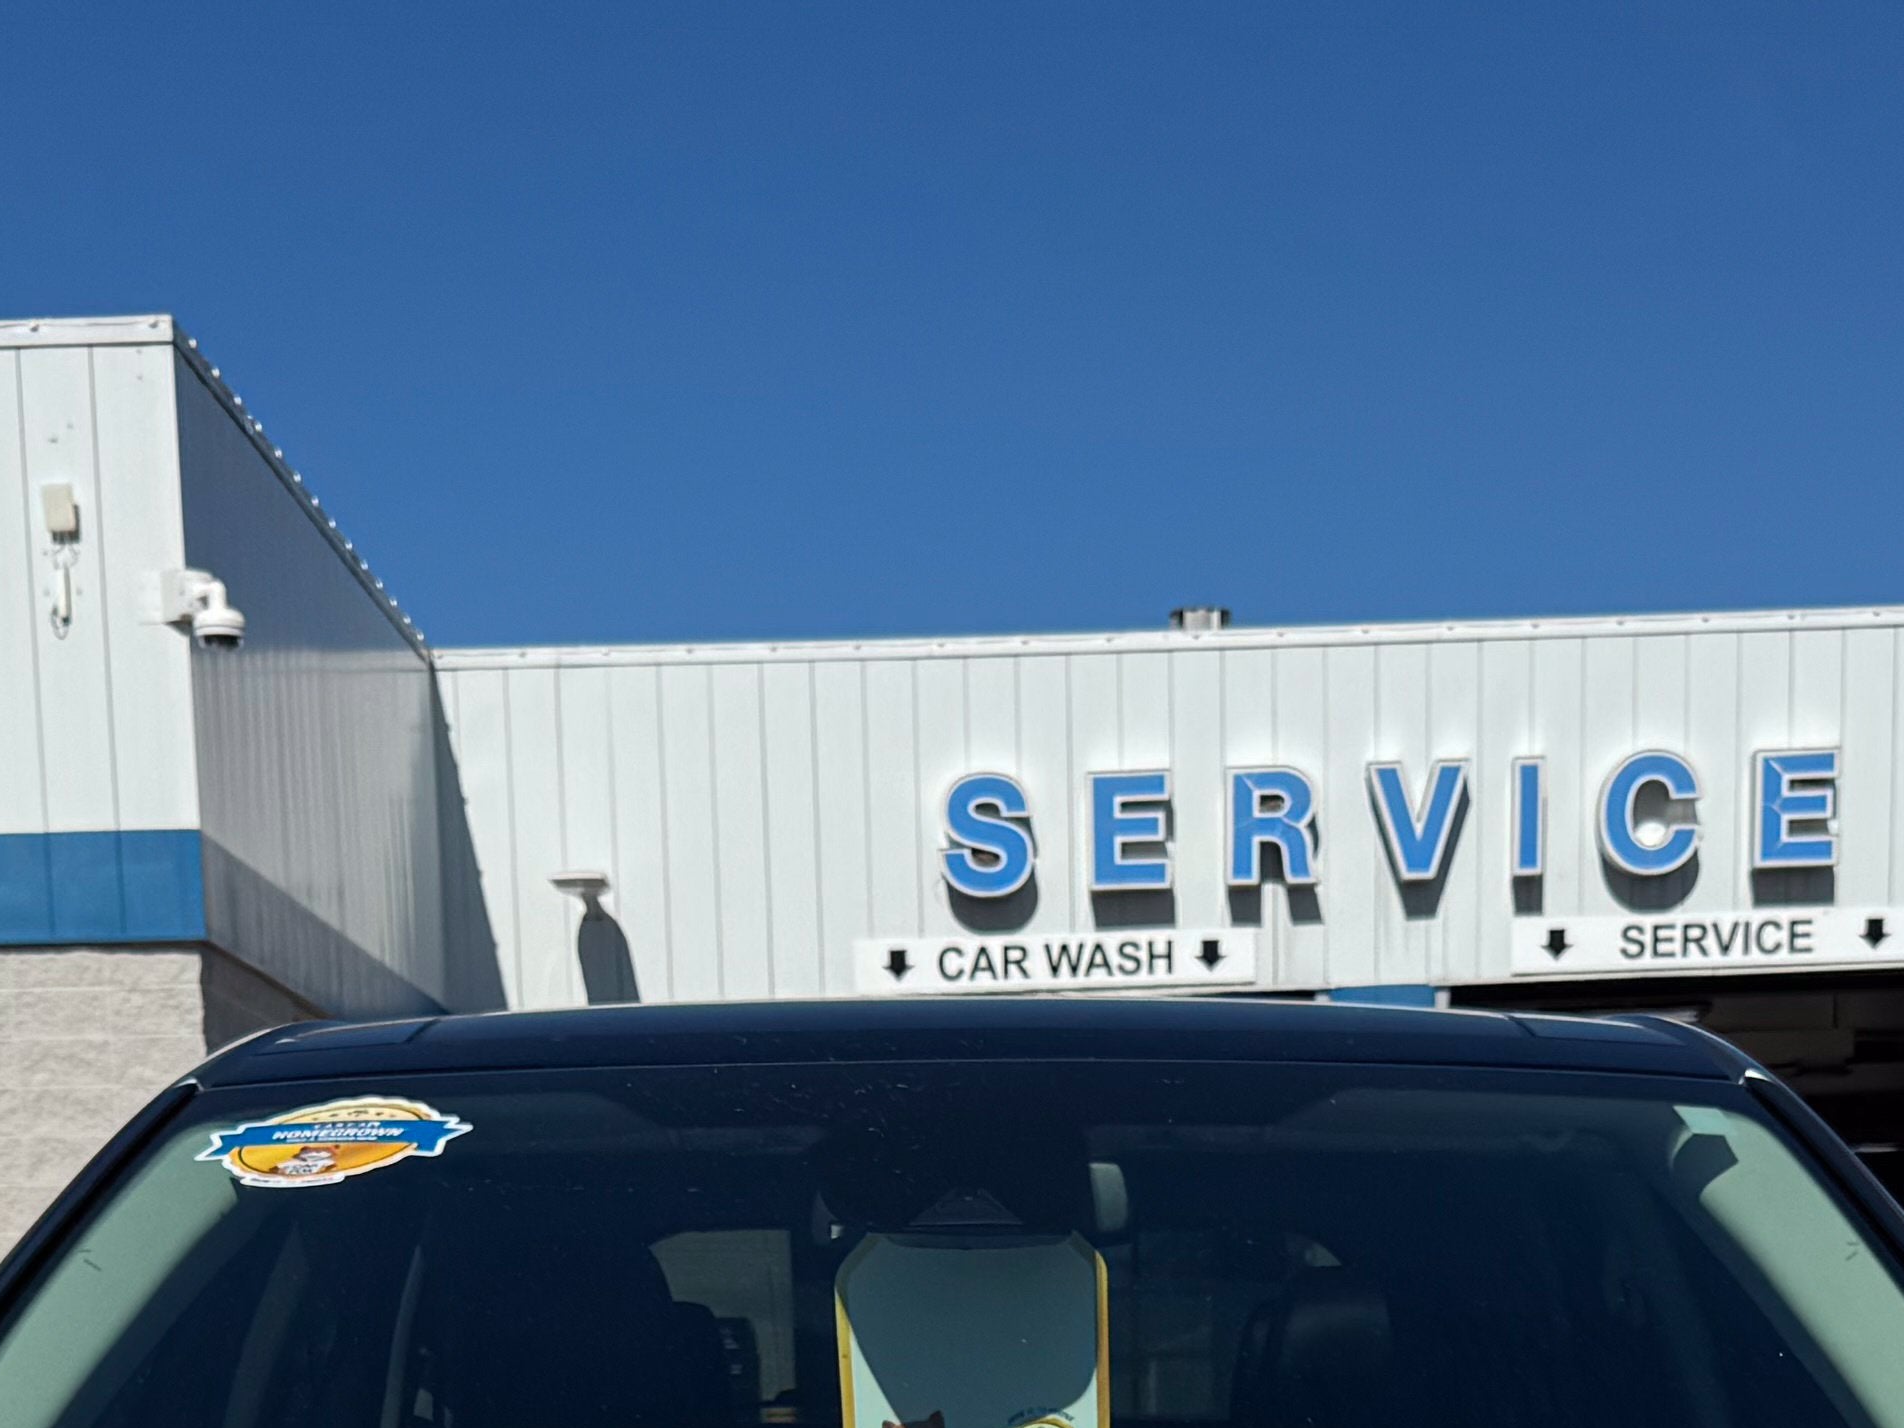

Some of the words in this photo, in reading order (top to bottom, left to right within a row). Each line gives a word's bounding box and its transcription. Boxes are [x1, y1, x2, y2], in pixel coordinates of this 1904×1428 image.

[941, 748, 1842, 900] SERVICE
[937, 945, 1031, 982] CAR
[1044, 938, 1174, 979] WASH
[1619, 918, 1814, 960] SERVICE
